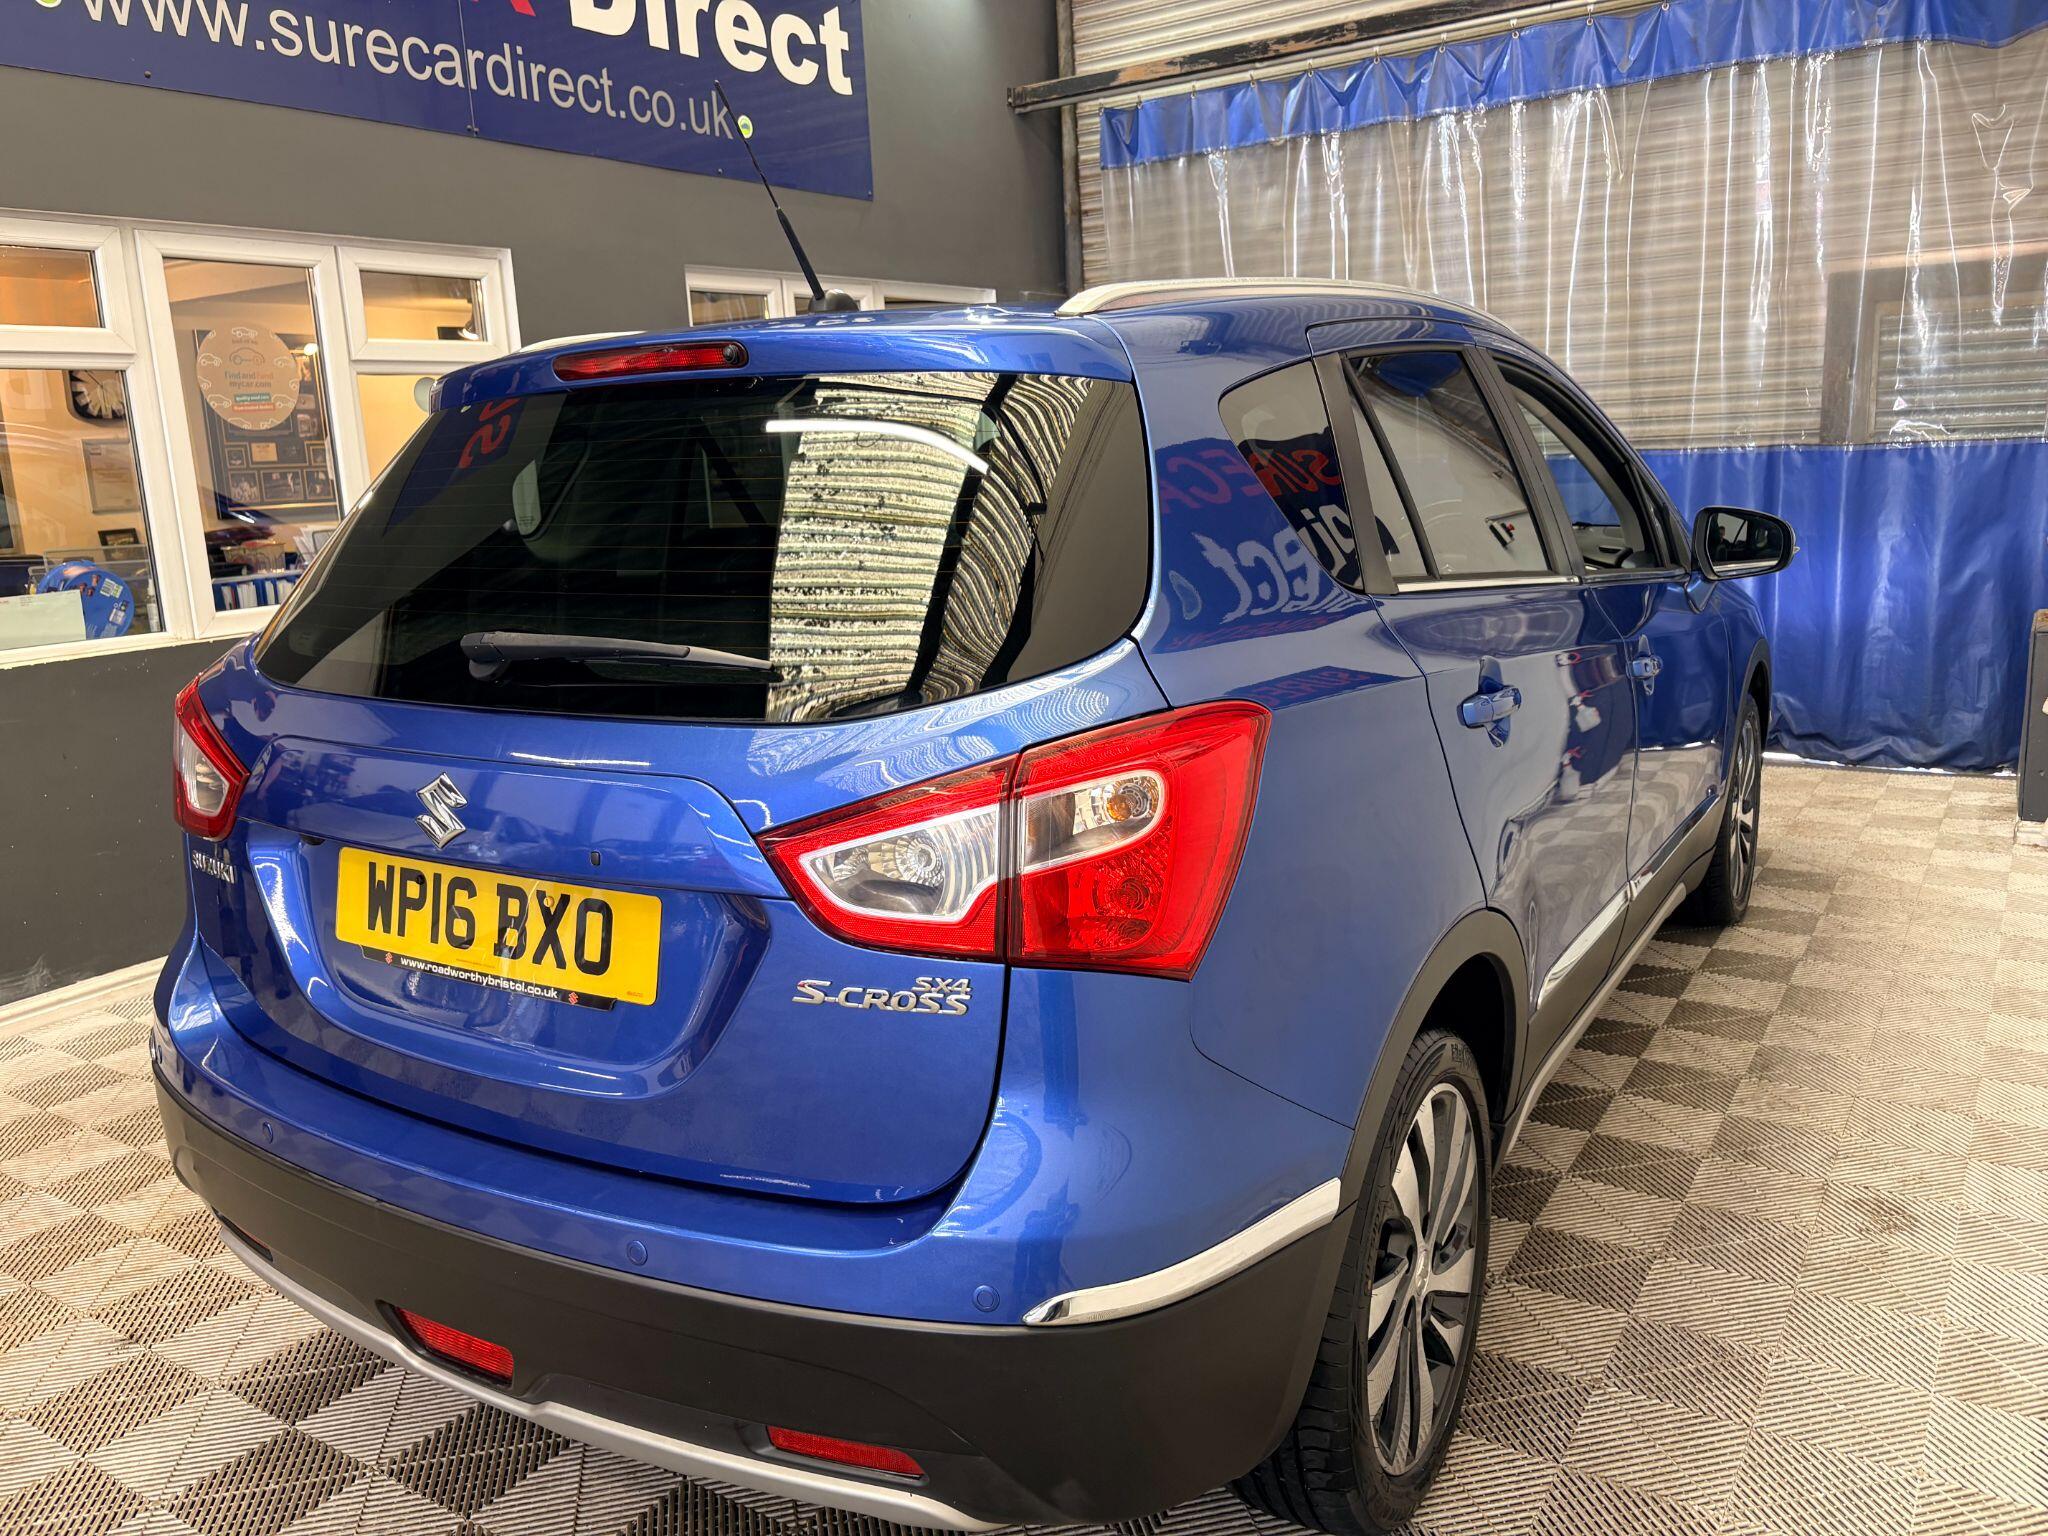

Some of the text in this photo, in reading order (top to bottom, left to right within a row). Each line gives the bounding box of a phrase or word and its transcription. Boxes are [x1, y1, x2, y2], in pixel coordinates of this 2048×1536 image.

[192, 850, 236, 884] SUZUKI
[367, 861, 614, 977] WP16 BXO
[400, 956, 559, 999] www.roadworthybristol.co.uk
[911, 976, 972, 993] SX4
[792, 979, 972, 1016] S-CROSS
